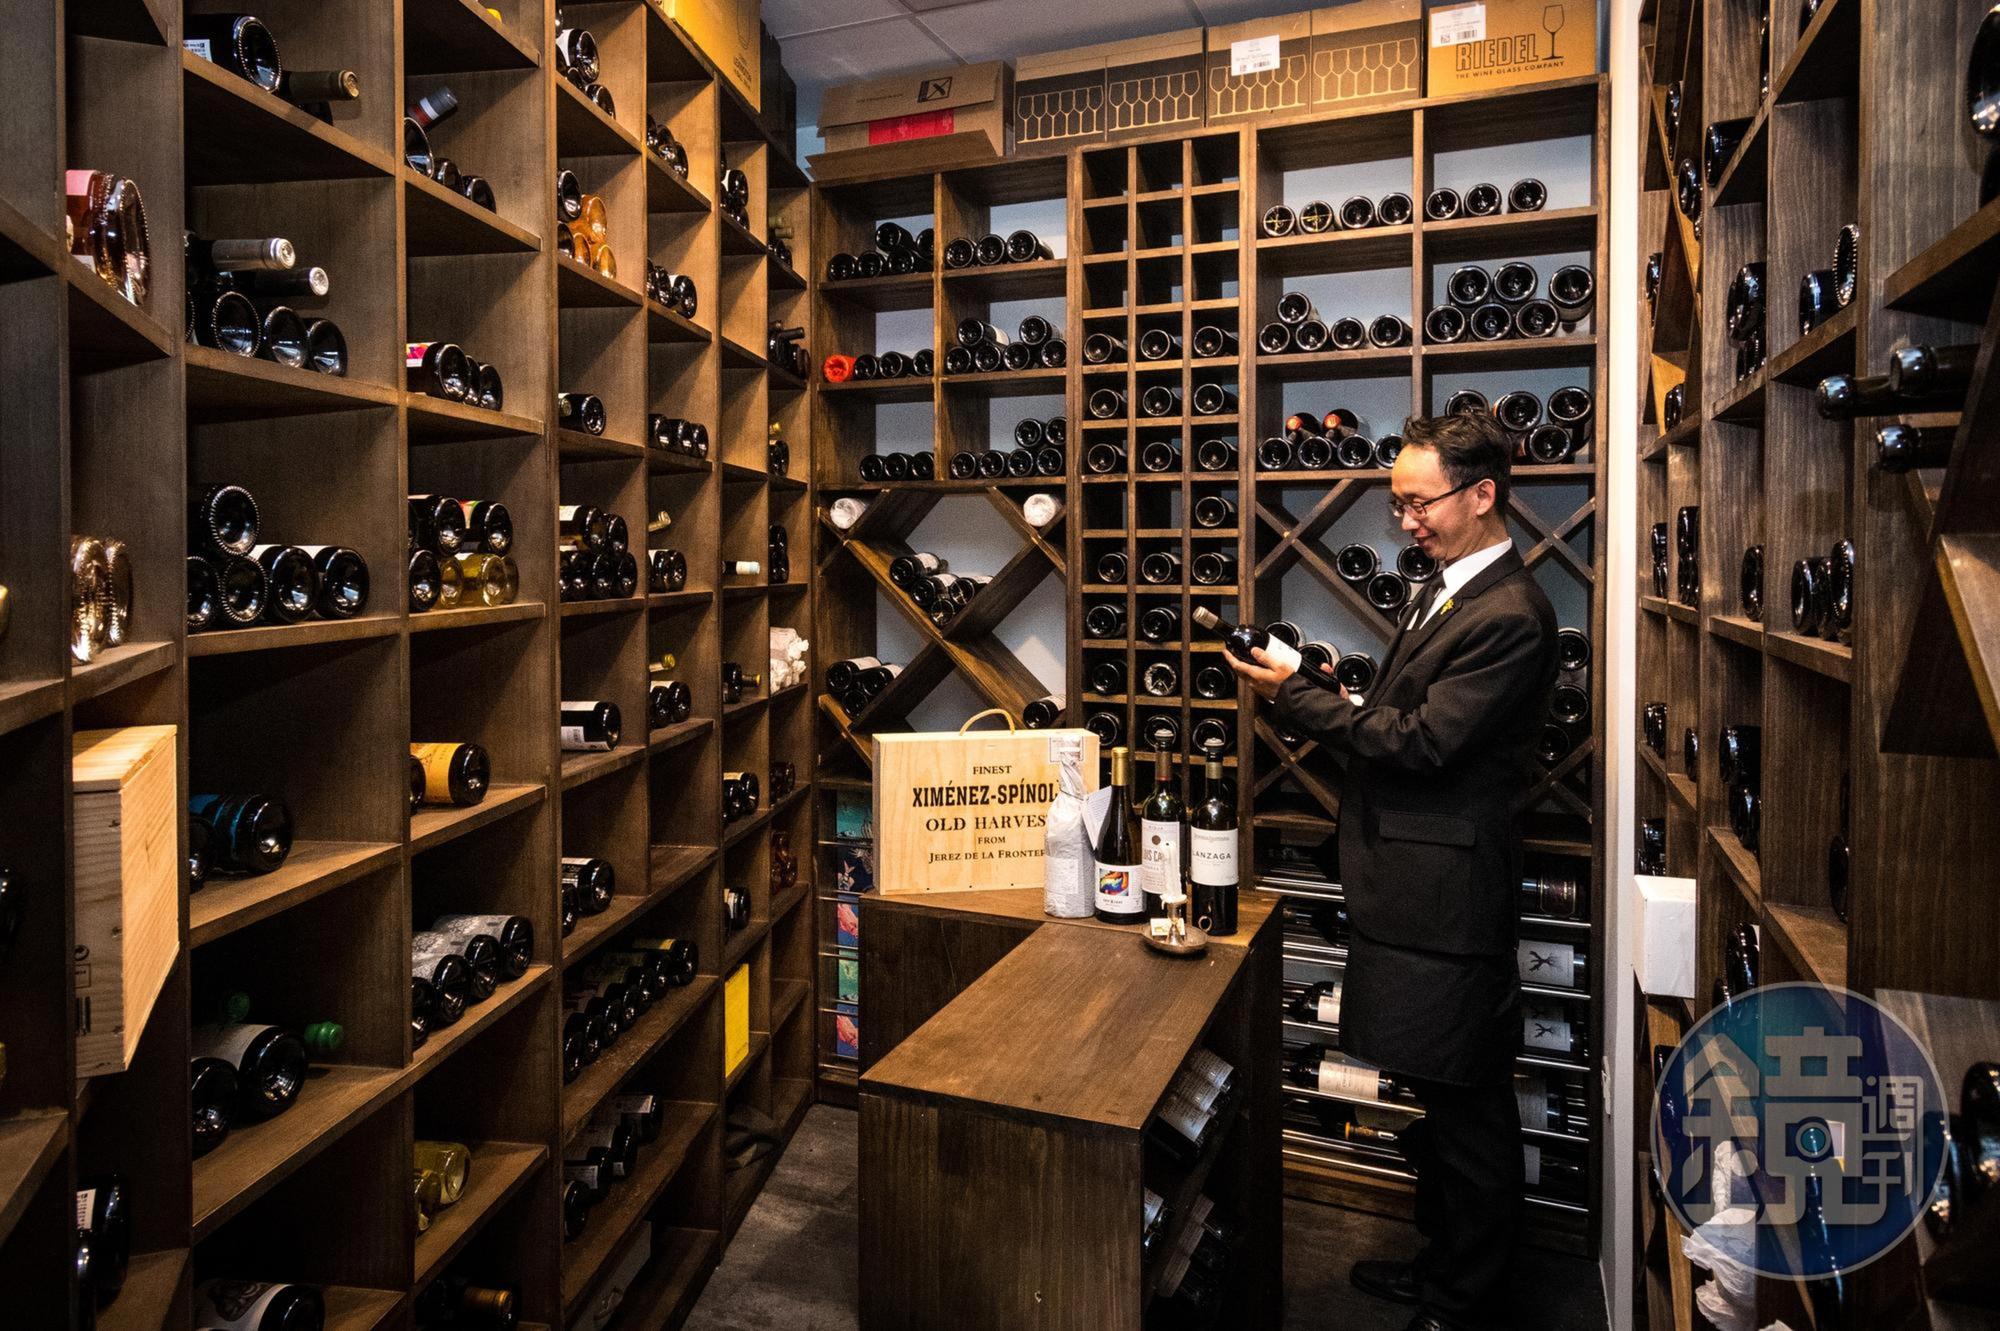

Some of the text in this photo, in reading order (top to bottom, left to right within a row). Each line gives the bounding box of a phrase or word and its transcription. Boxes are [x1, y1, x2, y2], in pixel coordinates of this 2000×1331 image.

[1456, 33, 1538, 72] RIEDEL
[1473, 70, 1493, 78] WINE
[1496, 66, 1521, 74] GLASS
[1524, 61, 1564, 71] COMPANY
[973, 765, 1012, 775] FINEST
[912, 778, 1059, 807] XIMÉNEZ-SPÍNOL
[926, 814, 1047, 831] OLD HARVES
[978, 836, 1006, 845] FROM
[928, 852, 961, 864] JEREZ
[965, 852, 978, 860] DE
[982, 851, 994, 860] LA
